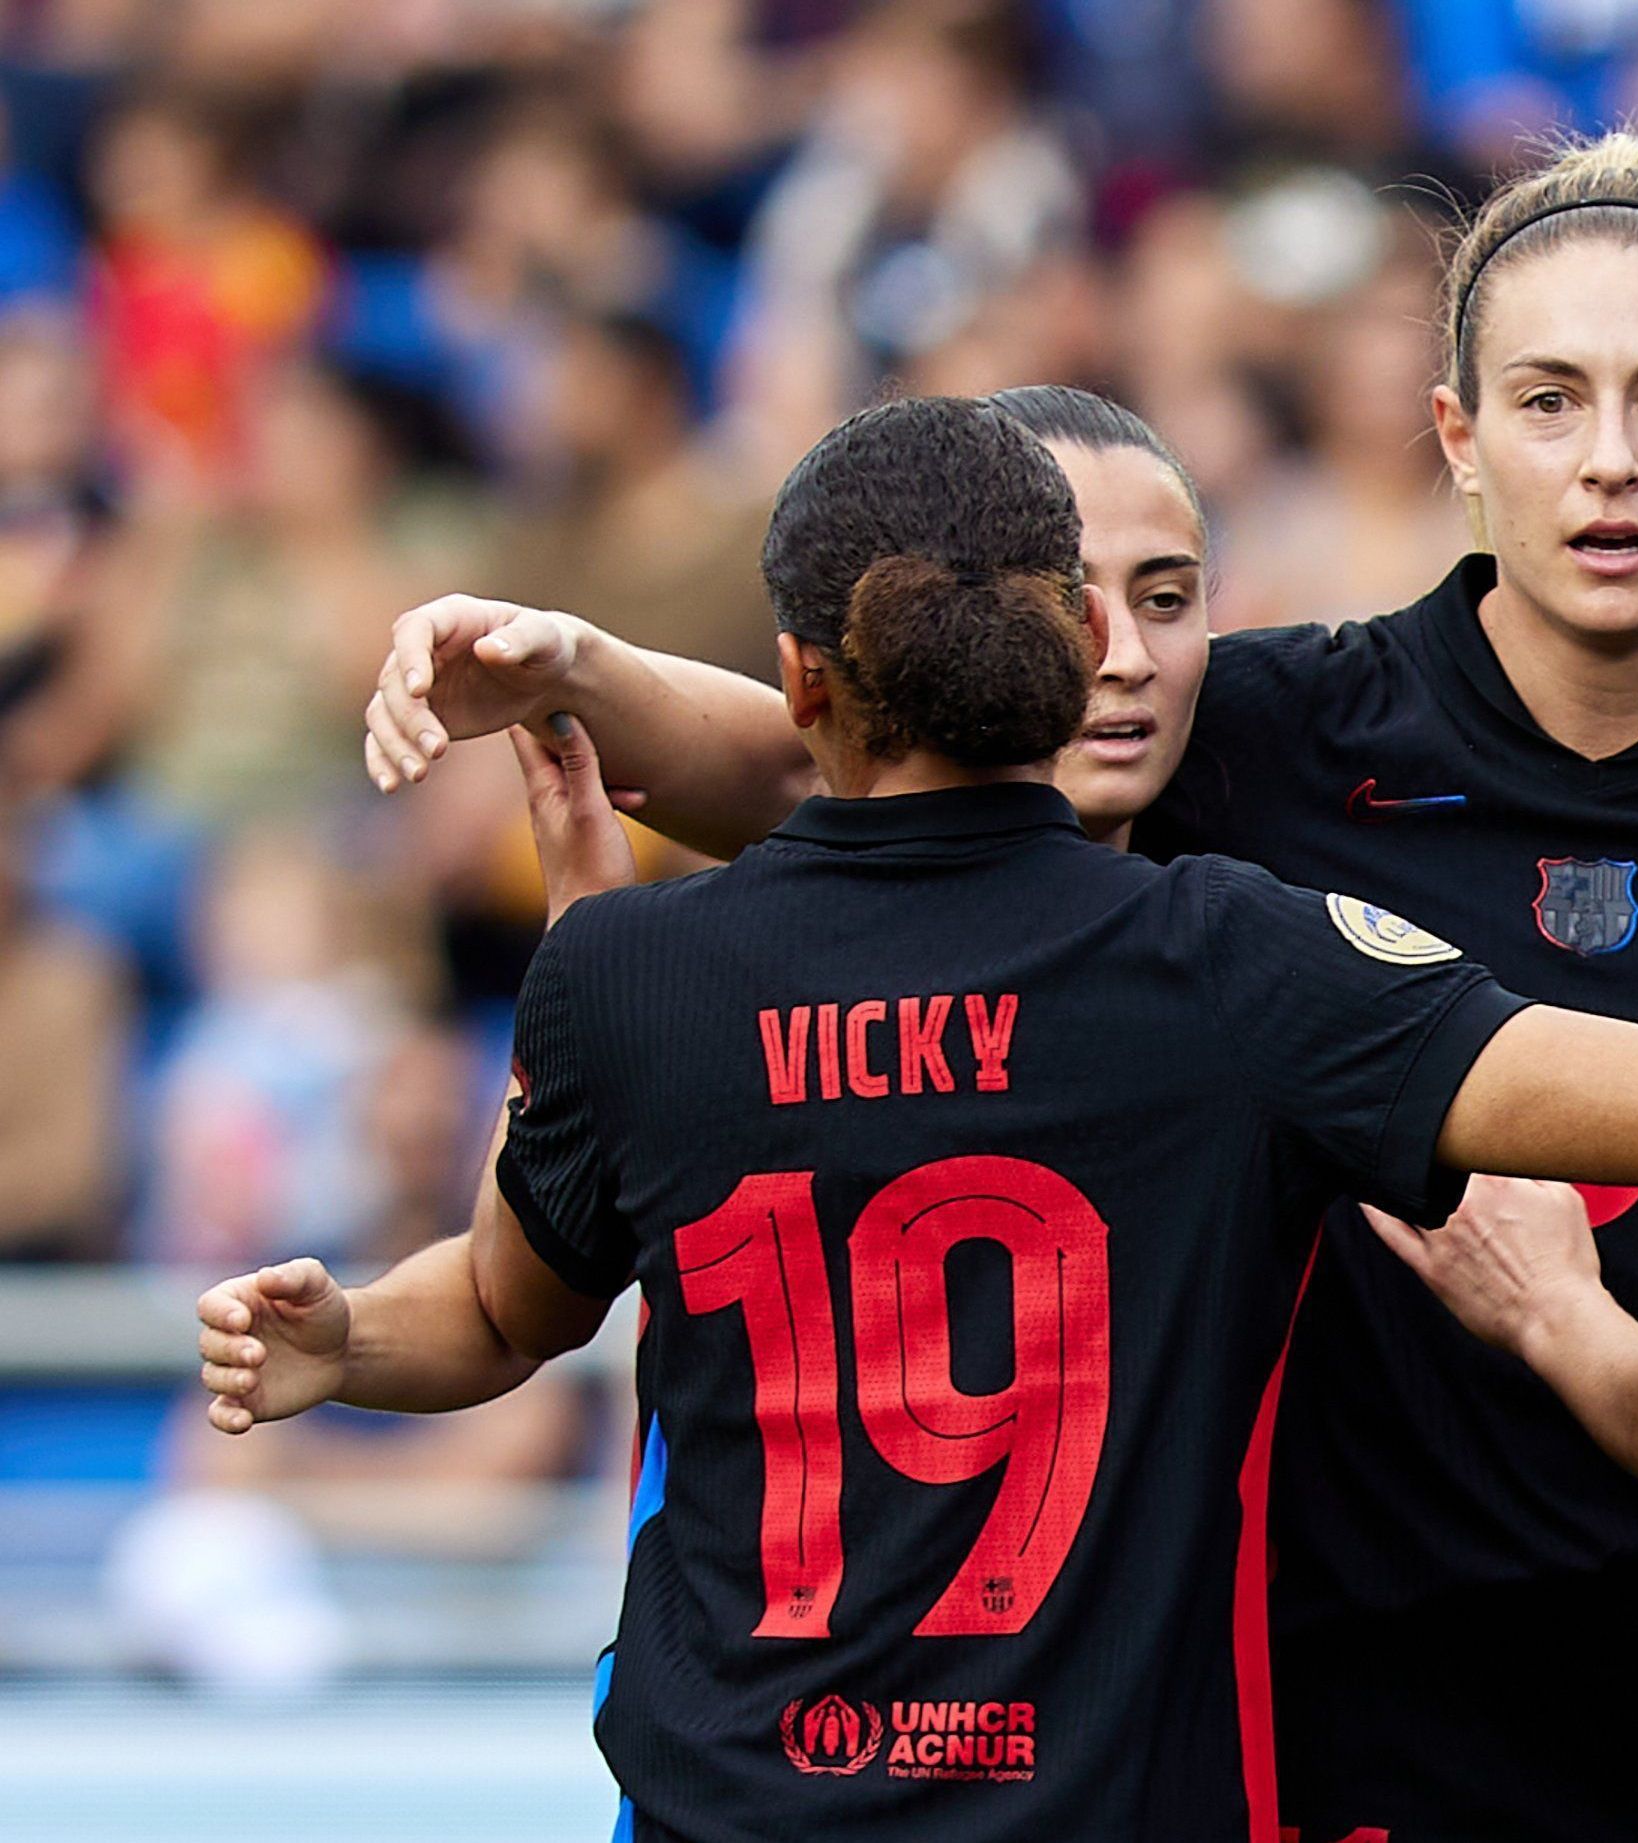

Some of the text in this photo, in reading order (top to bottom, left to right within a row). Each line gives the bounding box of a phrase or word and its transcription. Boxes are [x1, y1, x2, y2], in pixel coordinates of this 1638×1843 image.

[758, 994, 1019, 1105] VICKY
[673, 1154, 1111, 1637] 19
[892, 1701, 1035, 1733] UNHCR
[887, 1733, 1035, 1766] ACNUR
[888, 1766, 910, 1778] The
[987, 1768, 1035, 1783] Agency
